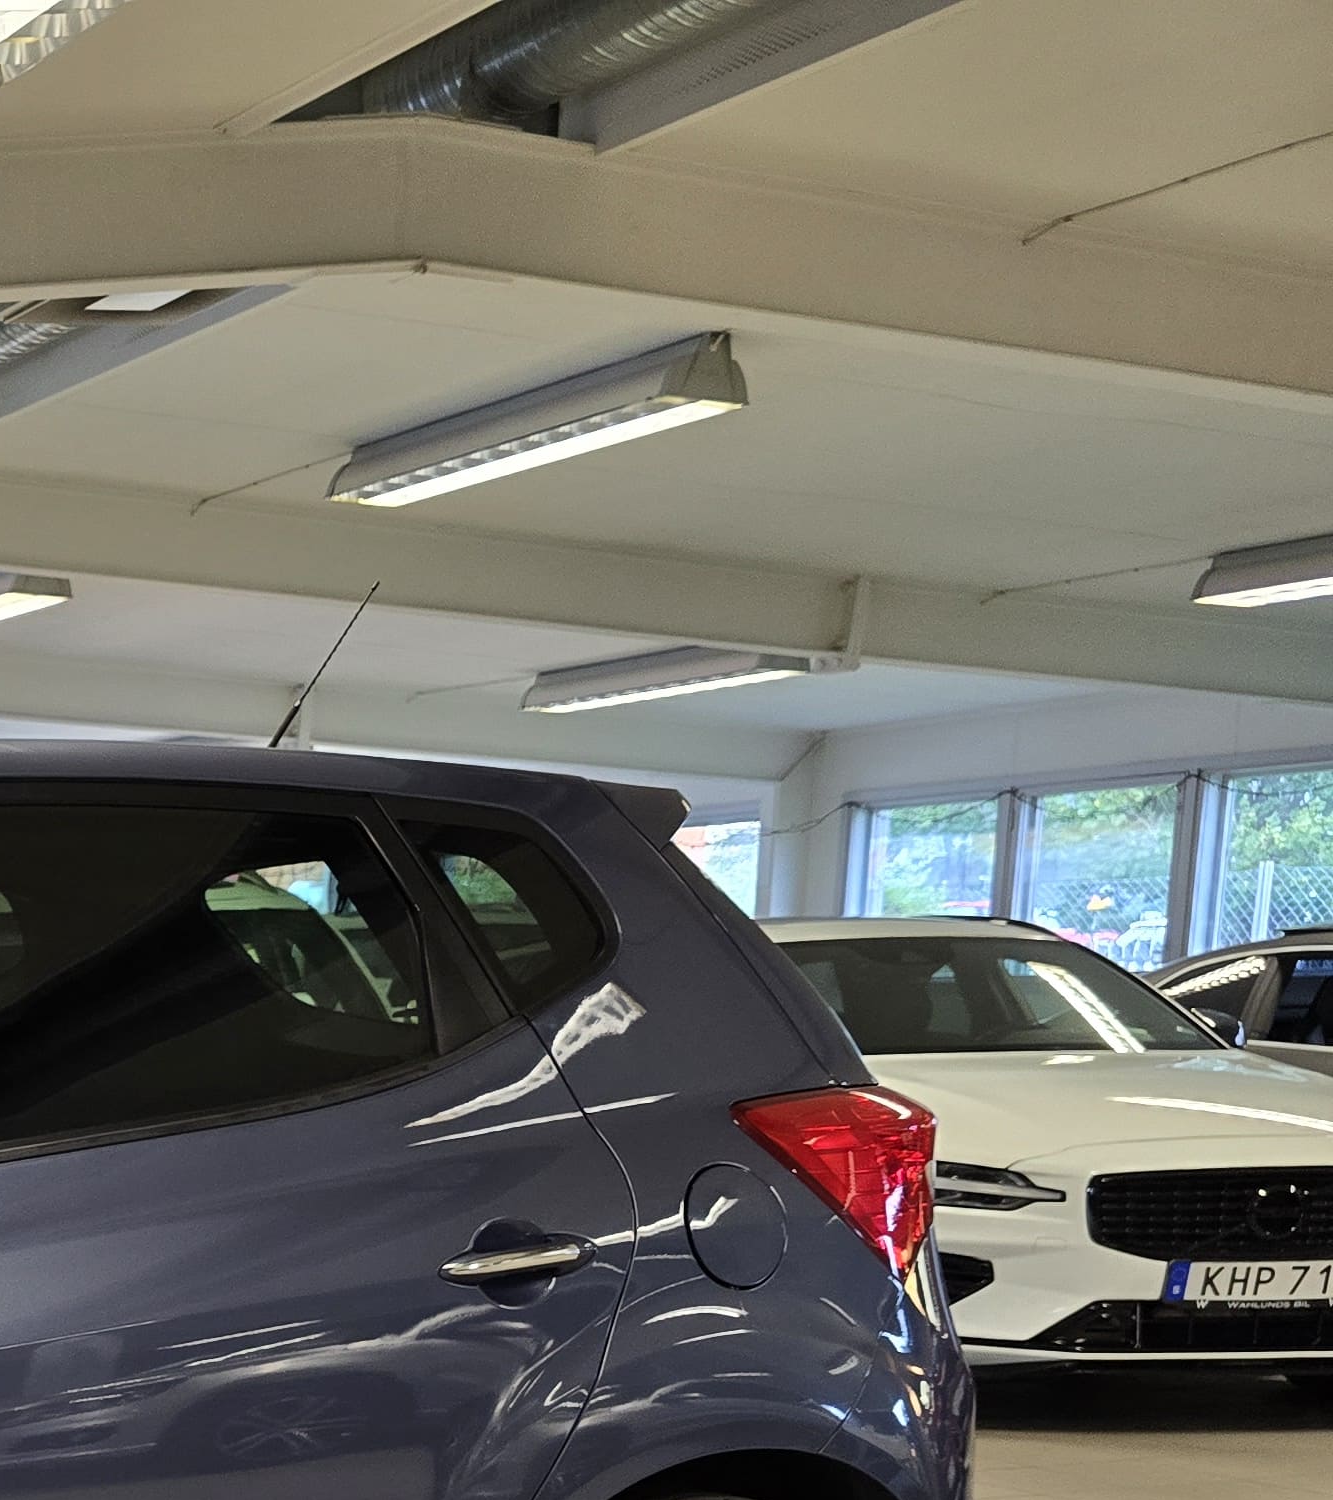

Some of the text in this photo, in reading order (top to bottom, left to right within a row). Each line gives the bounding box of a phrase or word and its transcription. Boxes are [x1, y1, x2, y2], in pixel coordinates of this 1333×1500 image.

[1200, 1265, 1276, 1296] KHP
[1227, 1300, 1311, 1310] WAHLUNDS BIL
